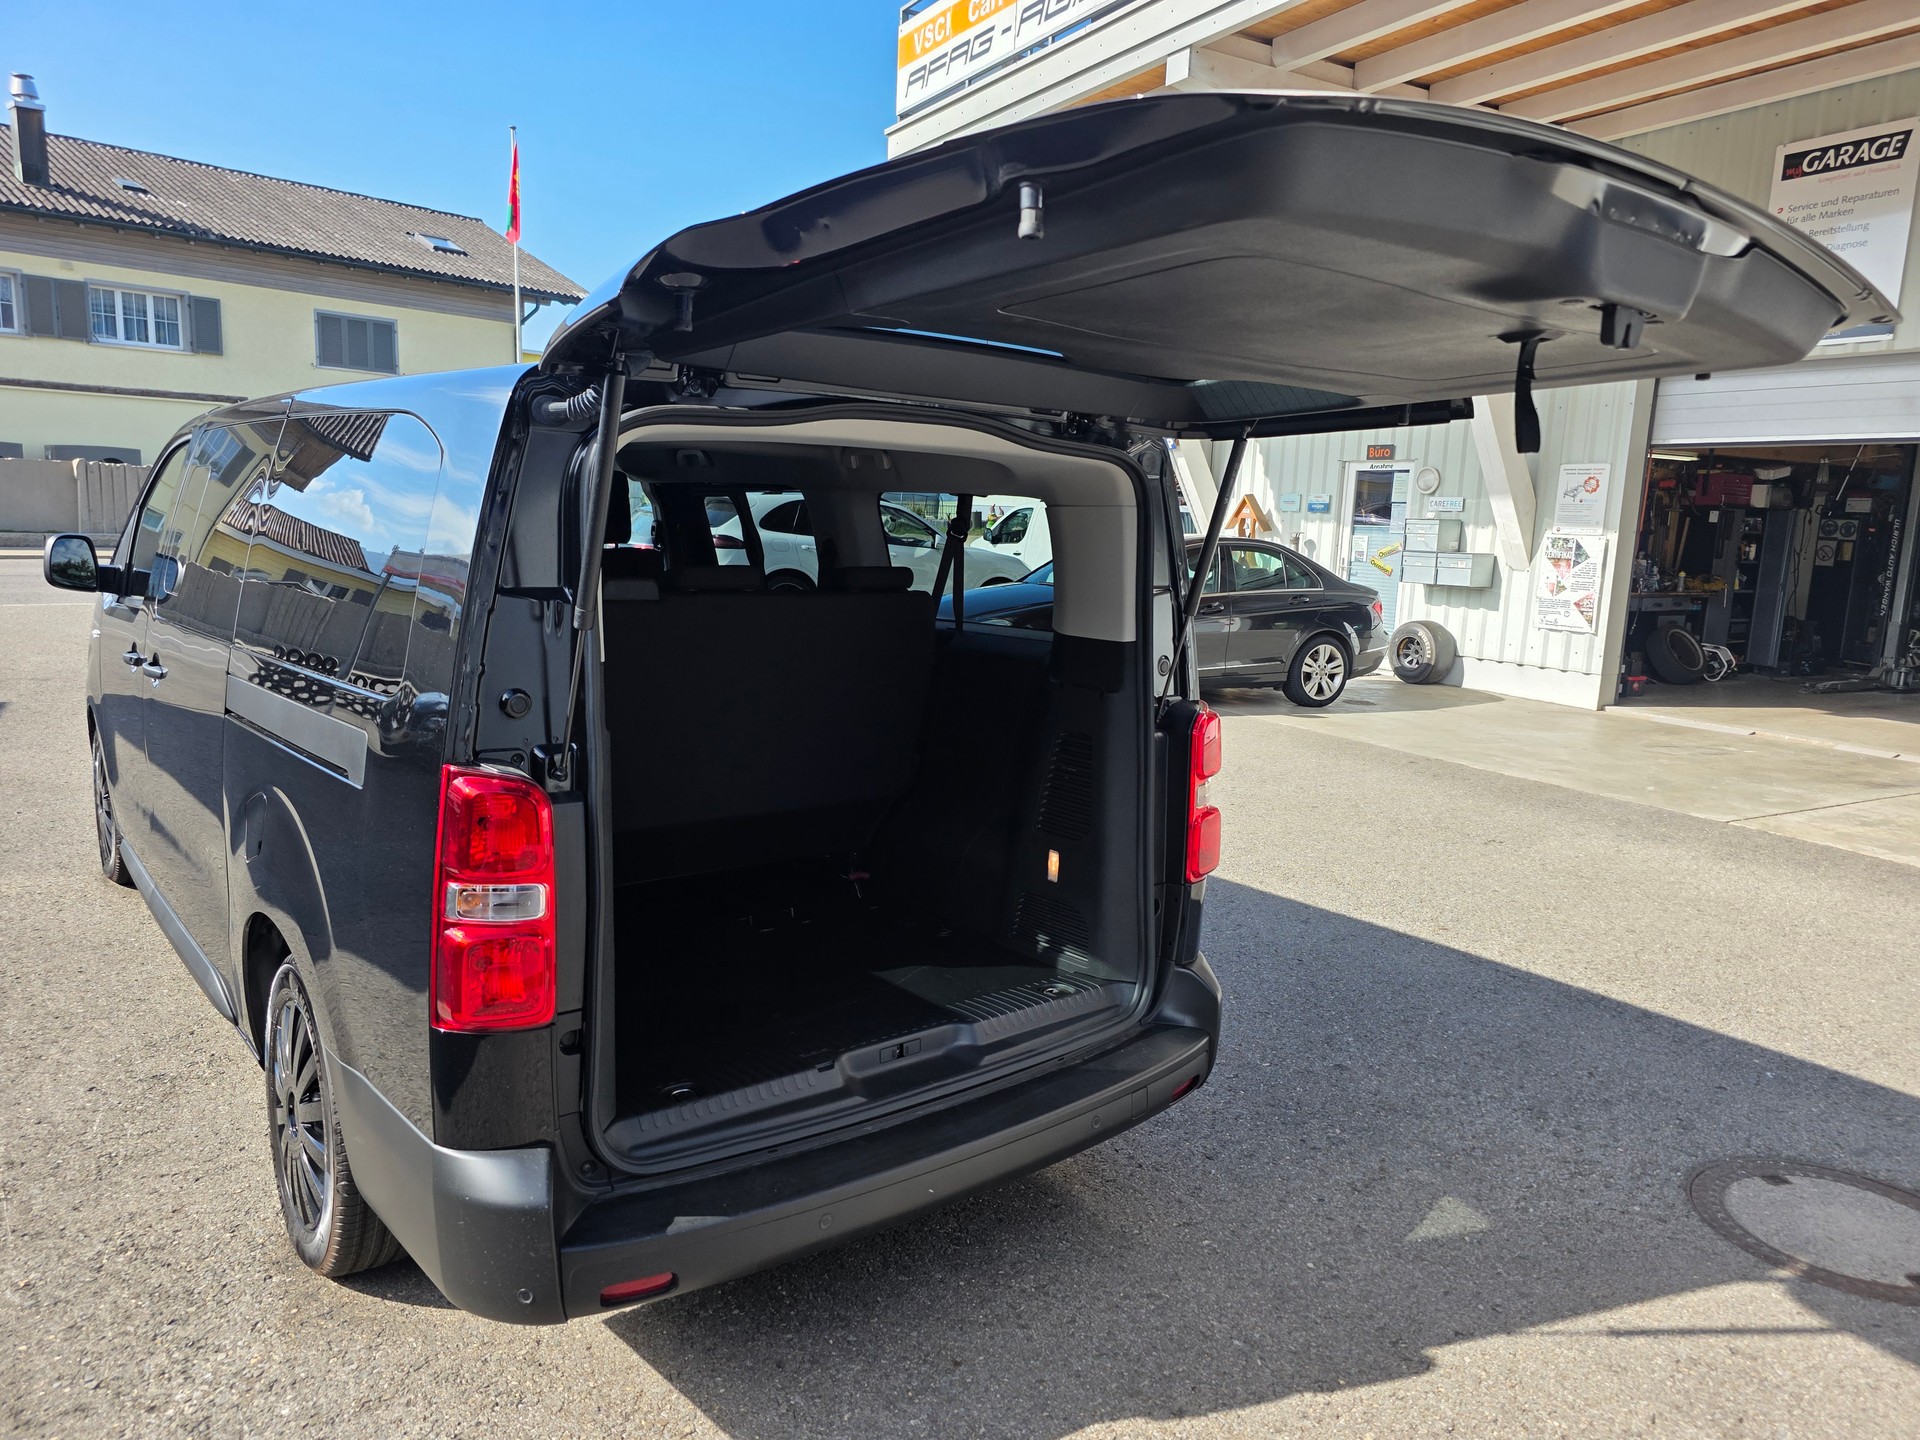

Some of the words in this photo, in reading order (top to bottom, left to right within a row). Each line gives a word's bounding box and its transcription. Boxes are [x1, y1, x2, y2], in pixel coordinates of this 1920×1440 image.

[914, 13, 951, 54] VSCI
[1787, 201, 1819, 214] Service
[1821, 197, 1839, 208] und
[1841, 188, 1900, 205] Reparaturen
[1786, 216, 1799, 226] für
[1800, 212, 1816, 223] alle
[1818, 207, 1854, 220] Marken
[1369, 446, 1391, 458] Büro
[1429, 500, 1462, 508] CAREFREE
[1889, 518, 1900, 552] ULRICH
[1886, 553, 1895, 578] AUTO
[1417, 631, 1432, 659] PIRELLI
